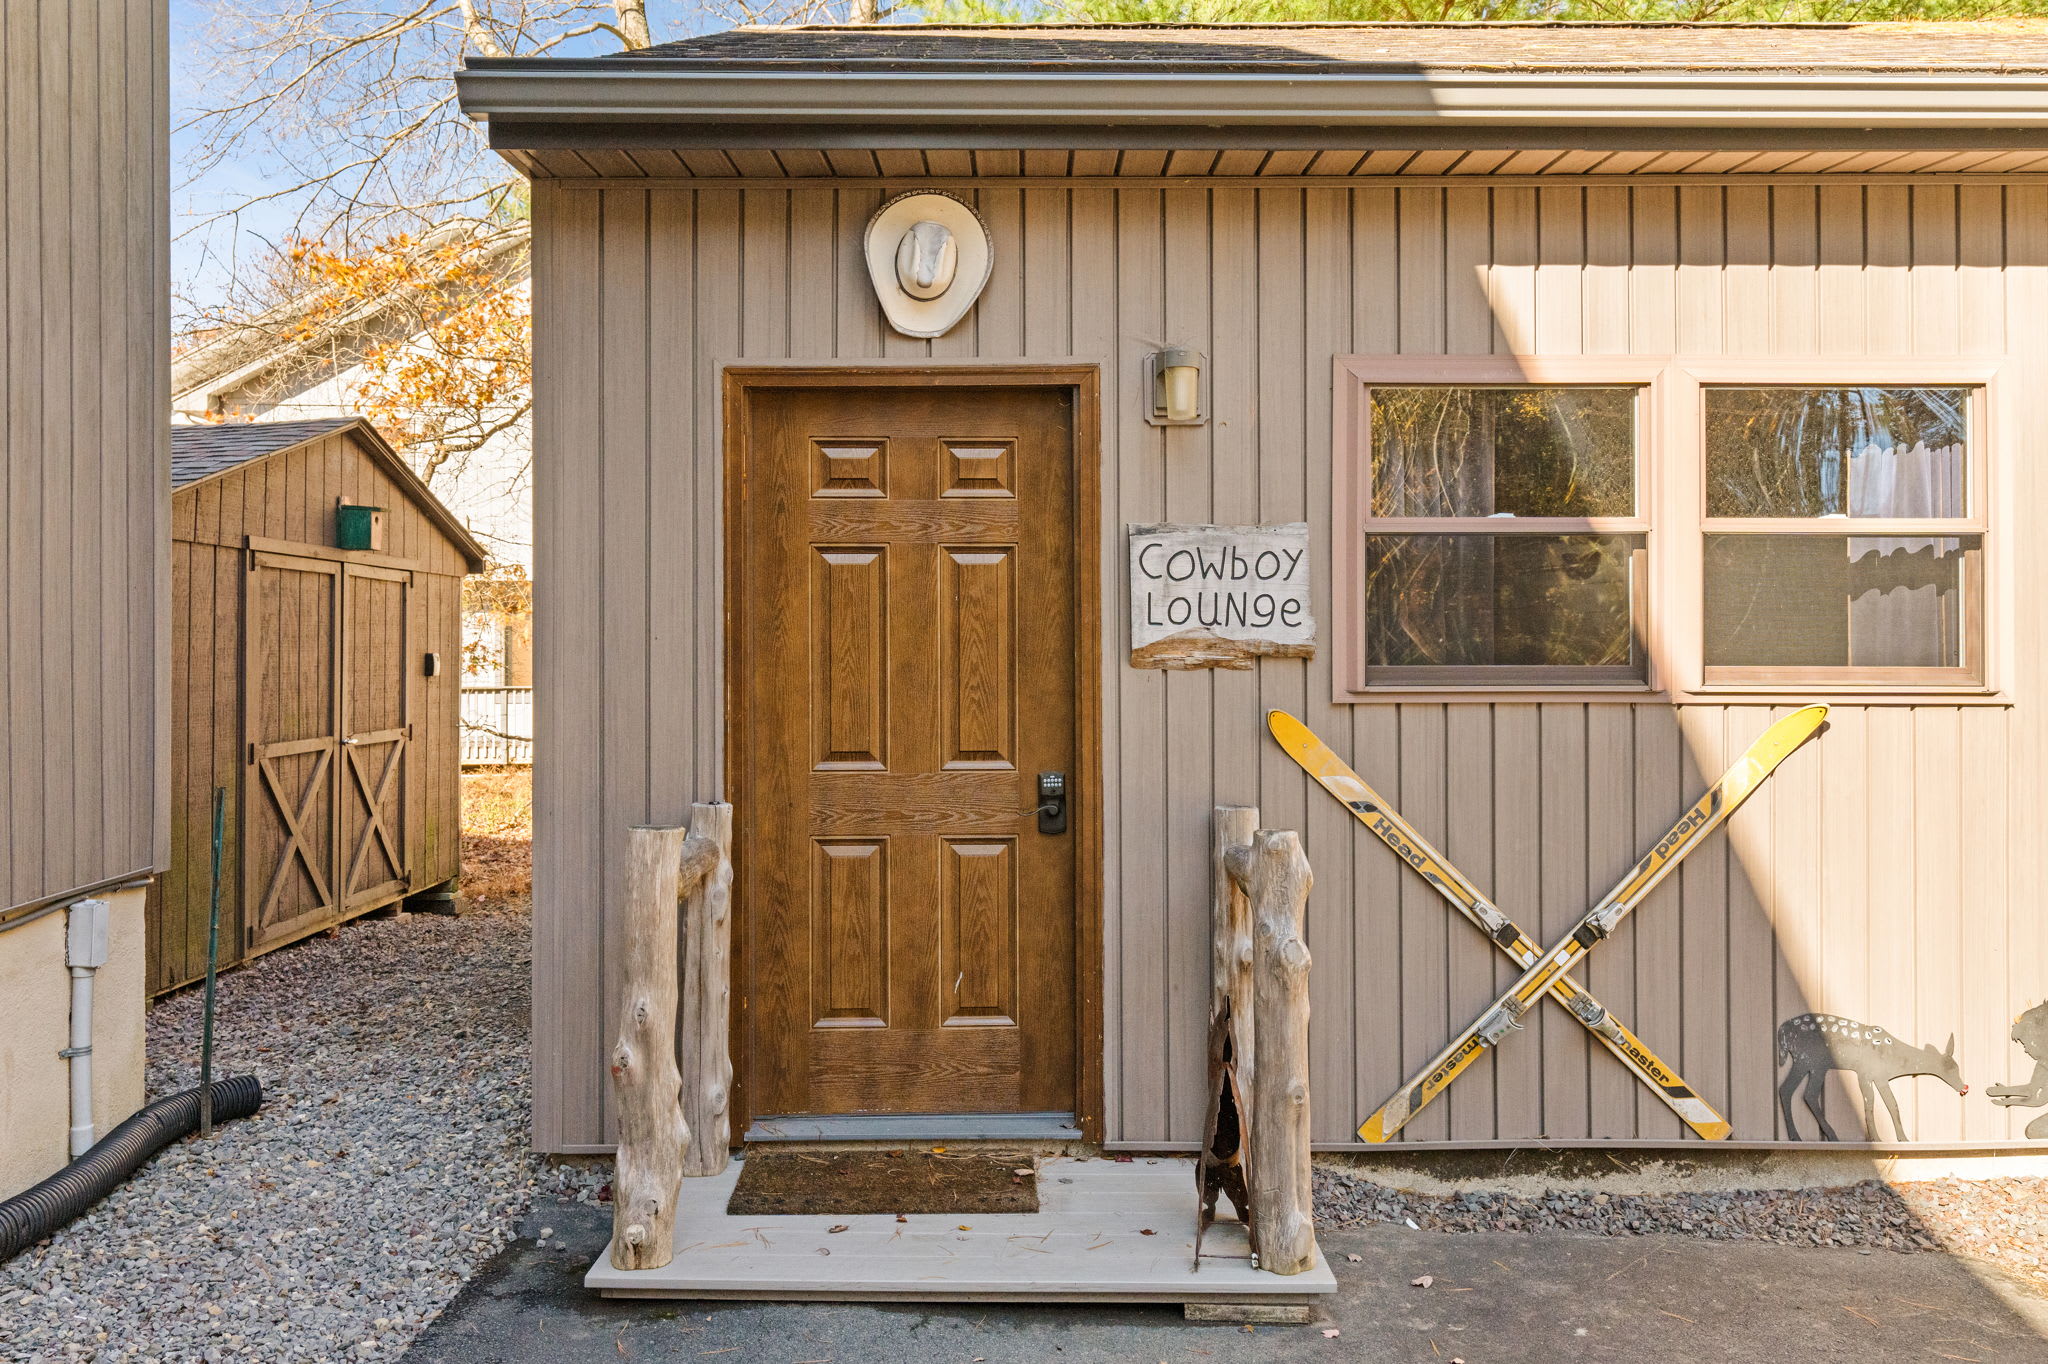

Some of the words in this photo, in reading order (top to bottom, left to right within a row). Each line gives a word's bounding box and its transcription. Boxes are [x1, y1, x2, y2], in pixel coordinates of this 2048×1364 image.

[1373, 817, 1427, 868] Head
[1655, 807, 1707, 860] Head
[1426, 1039, 1479, 1090] master
